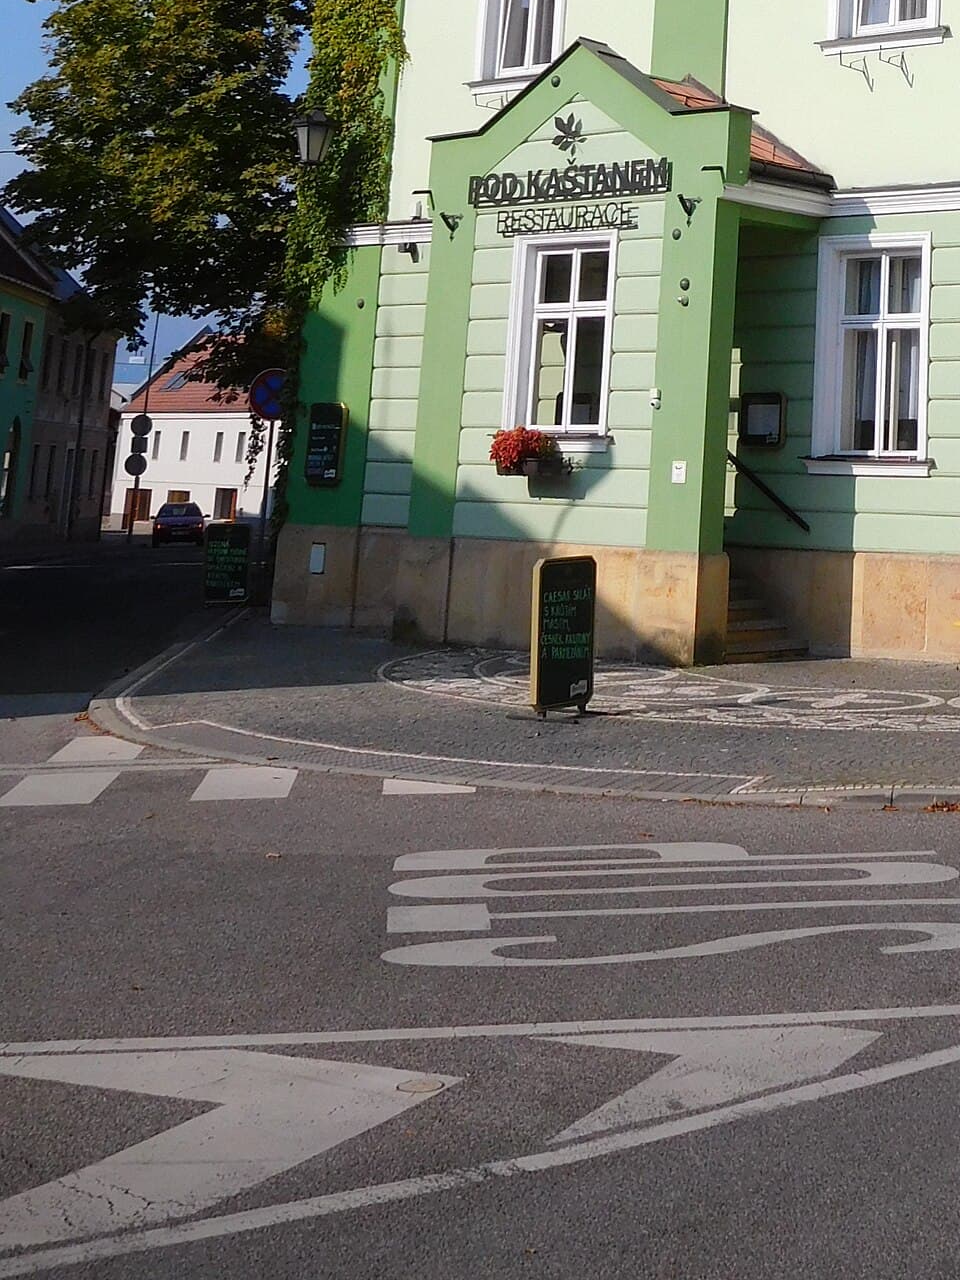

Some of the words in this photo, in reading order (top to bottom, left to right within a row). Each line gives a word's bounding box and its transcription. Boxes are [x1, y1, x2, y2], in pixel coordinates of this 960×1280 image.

[468, 172, 518, 205] POD
[527, 157, 668, 201] KAŠTANEM
[497, 201, 634, 233] RESTAURACE
